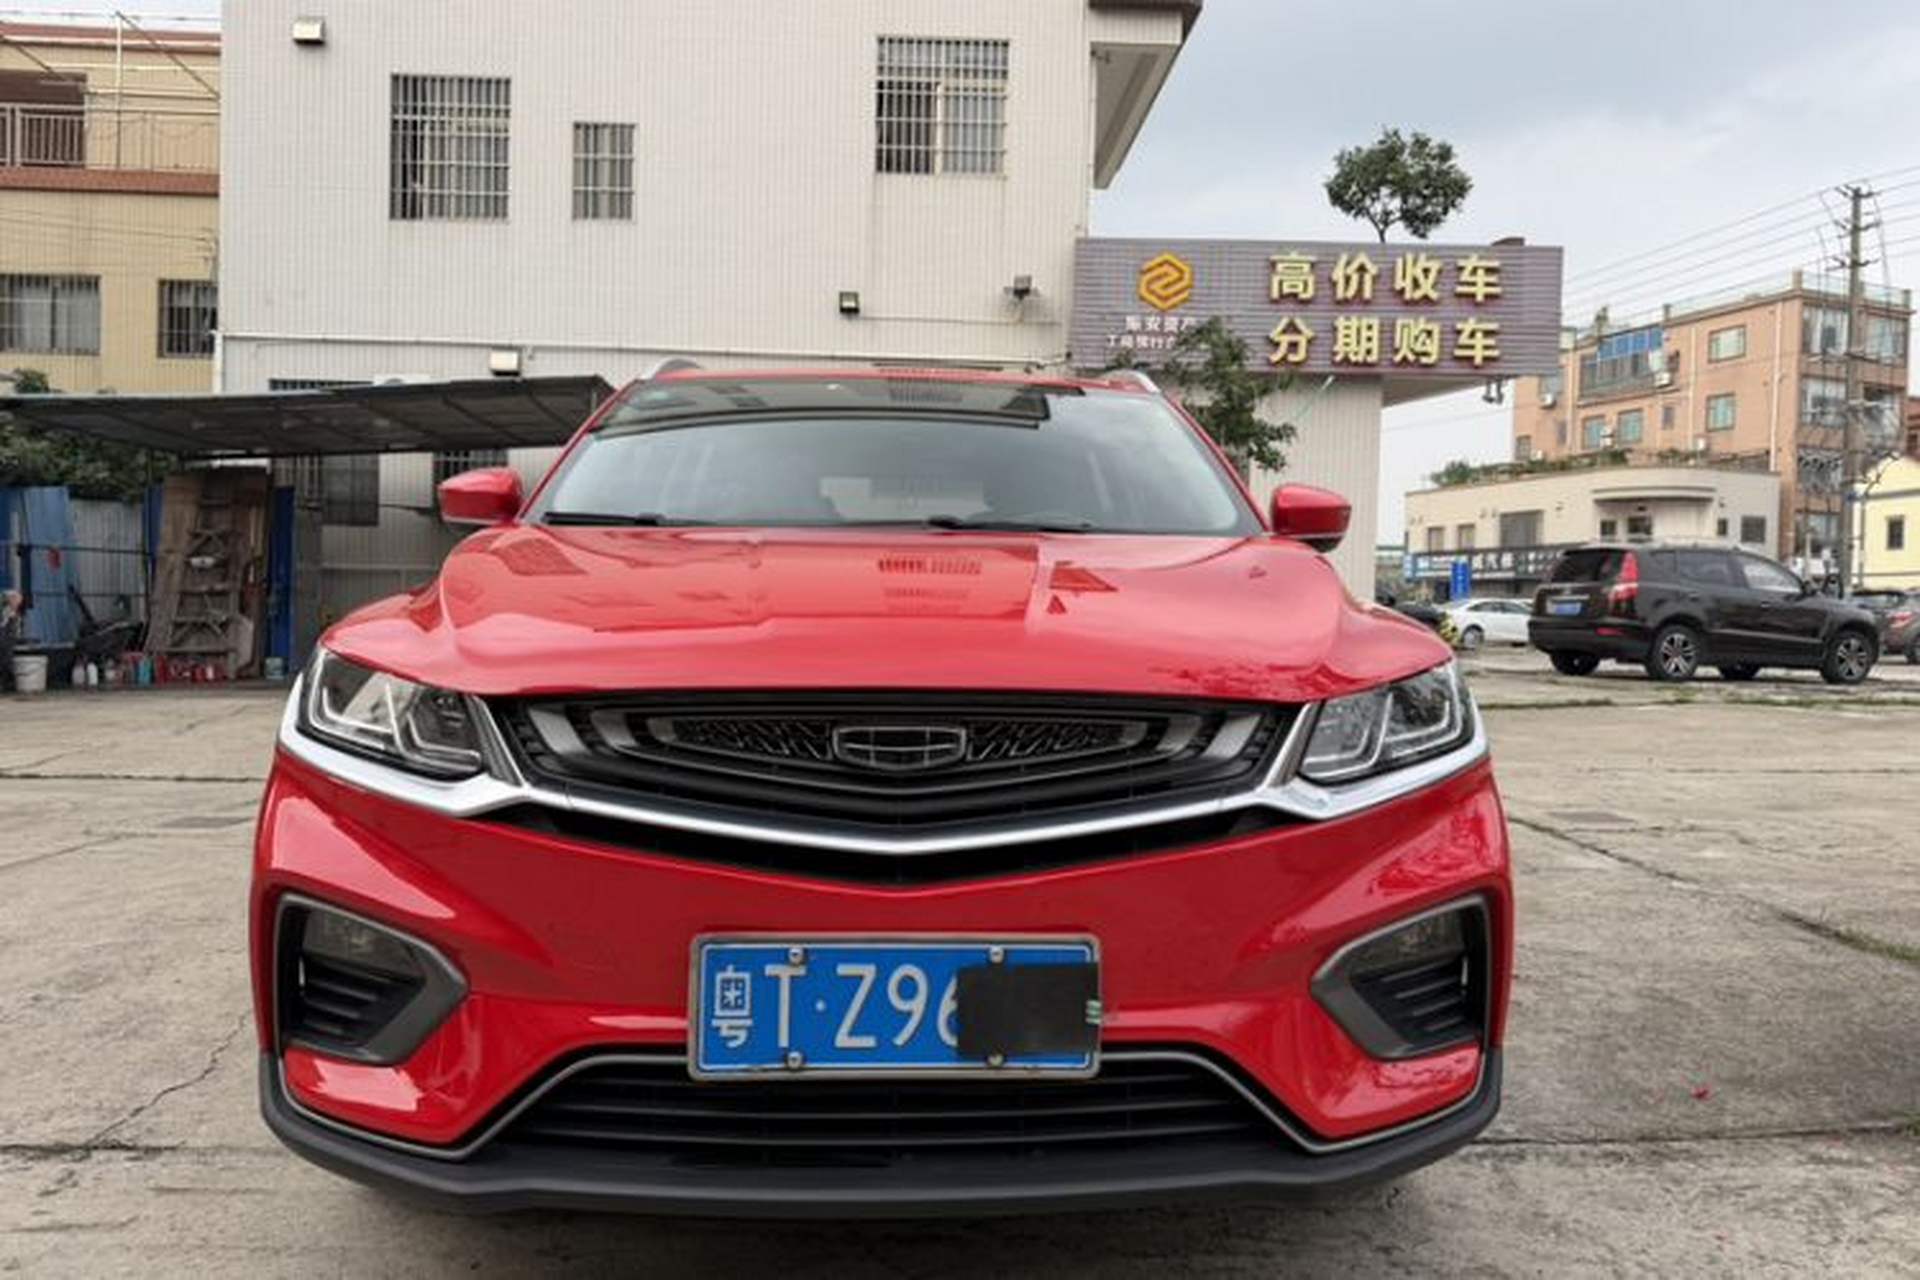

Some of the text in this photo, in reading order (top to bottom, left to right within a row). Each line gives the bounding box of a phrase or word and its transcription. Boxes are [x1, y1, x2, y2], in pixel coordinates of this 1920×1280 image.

[1269, 251, 1502, 302] 高价收车
[1268, 316, 1502, 365] 分期购车
[711, 963, 959, 1049] 粤T·Z96
